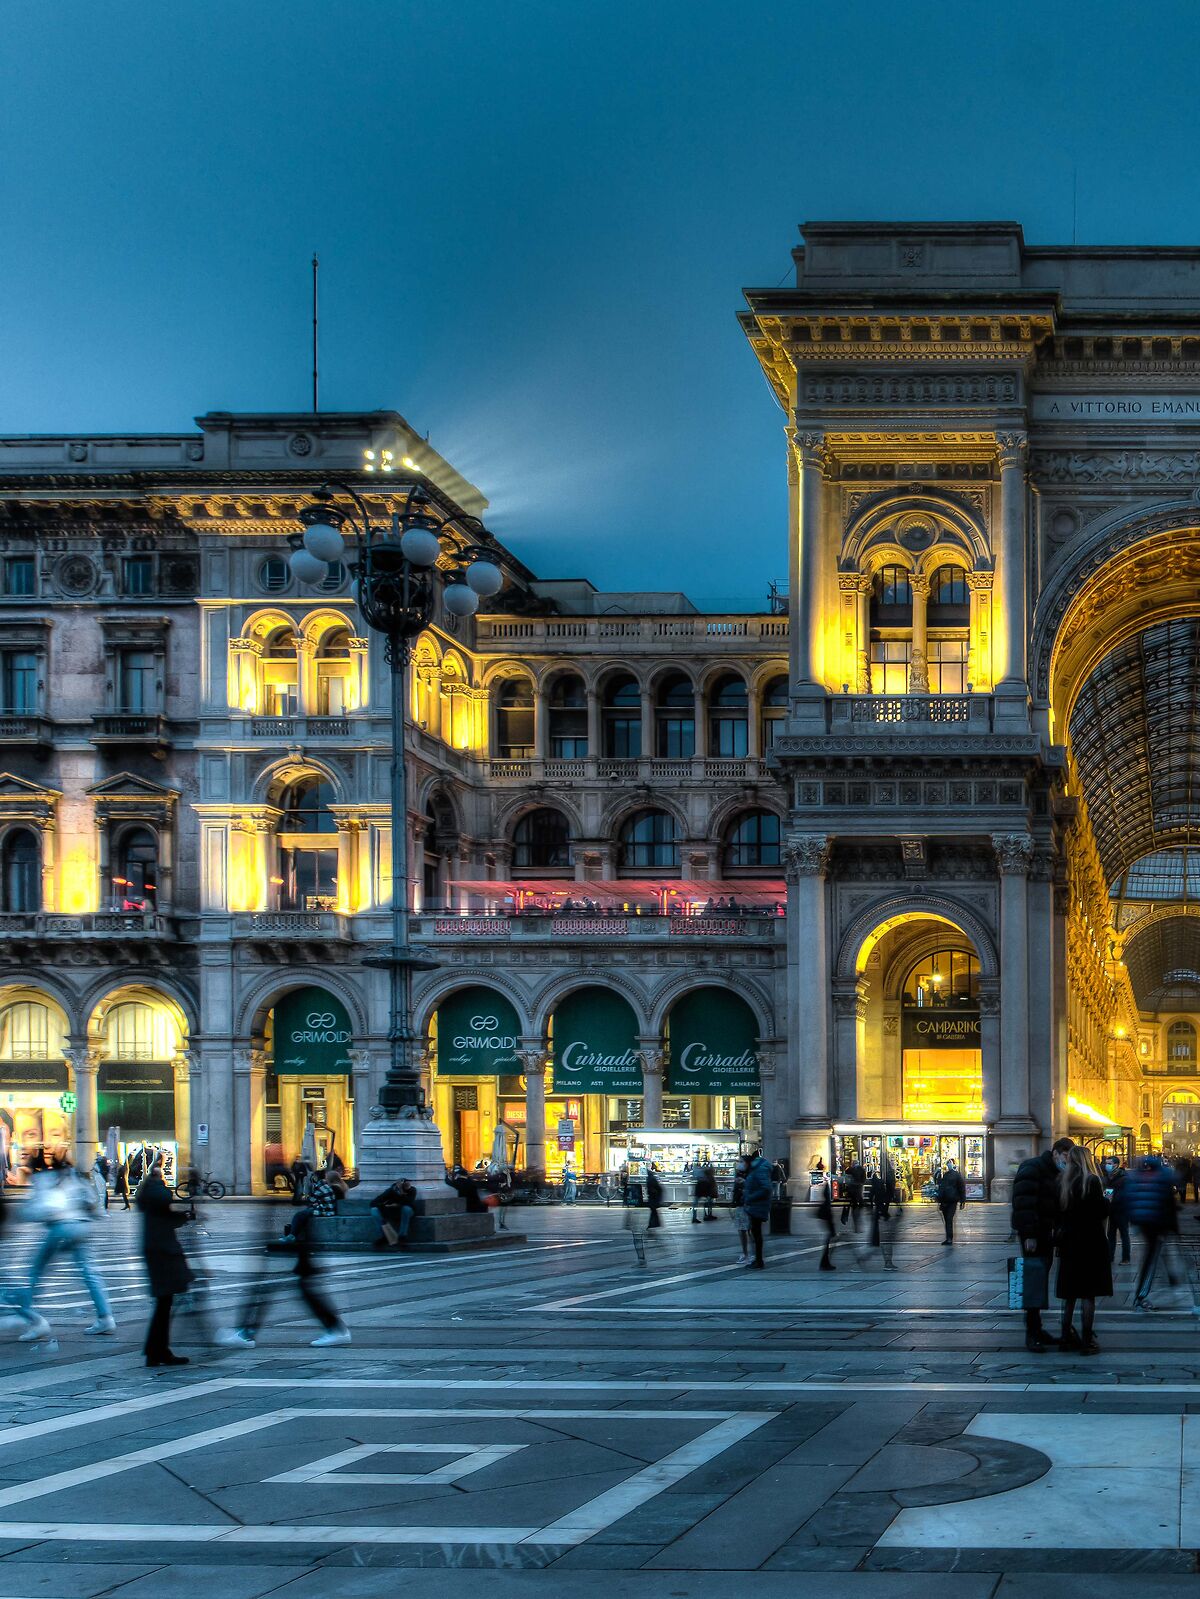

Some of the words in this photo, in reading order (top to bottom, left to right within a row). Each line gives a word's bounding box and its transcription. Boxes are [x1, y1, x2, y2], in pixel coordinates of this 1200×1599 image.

[1051, 402, 1060, 413] A
[1071, 402, 1142, 413] VITTORIO
[291, 1031, 352, 1043] GRIMOLDI
[453, 1036, 517, 1048] GRIMOLDI
[561, 1041, 638, 1071] Currado
[680, 1042, 755, 1072] Currado
